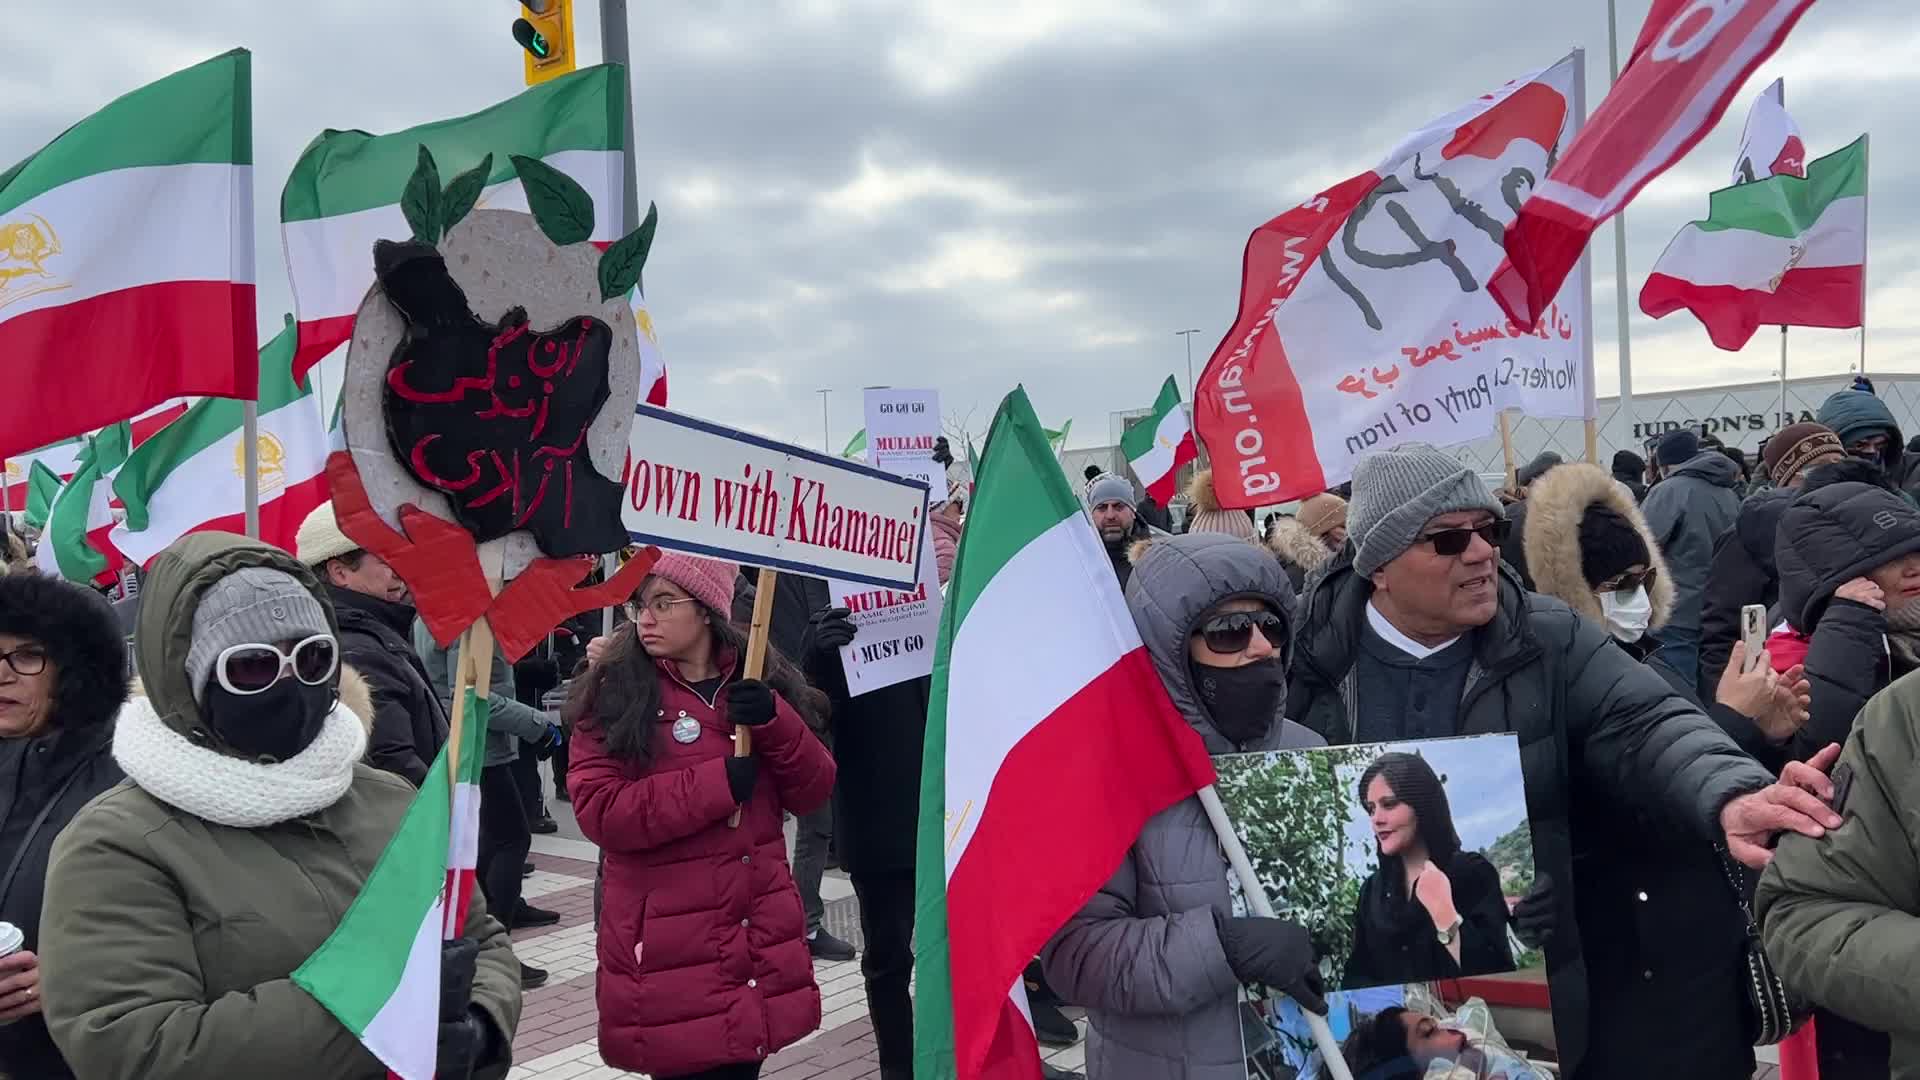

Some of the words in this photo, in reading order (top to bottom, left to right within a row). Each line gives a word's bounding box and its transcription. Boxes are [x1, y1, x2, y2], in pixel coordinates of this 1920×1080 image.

[880, 403, 893, 414] GO
[896, 403, 909, 414] GO
[912, 402, 925, 414] GO
[876, 436, 933, 450] MULLAH
[713, 463, 778, 537] with
[785, 475, 918, 565] Khamanei
[860, 639, 901, 664] MUST
[904, 634, 924, 653] GO
